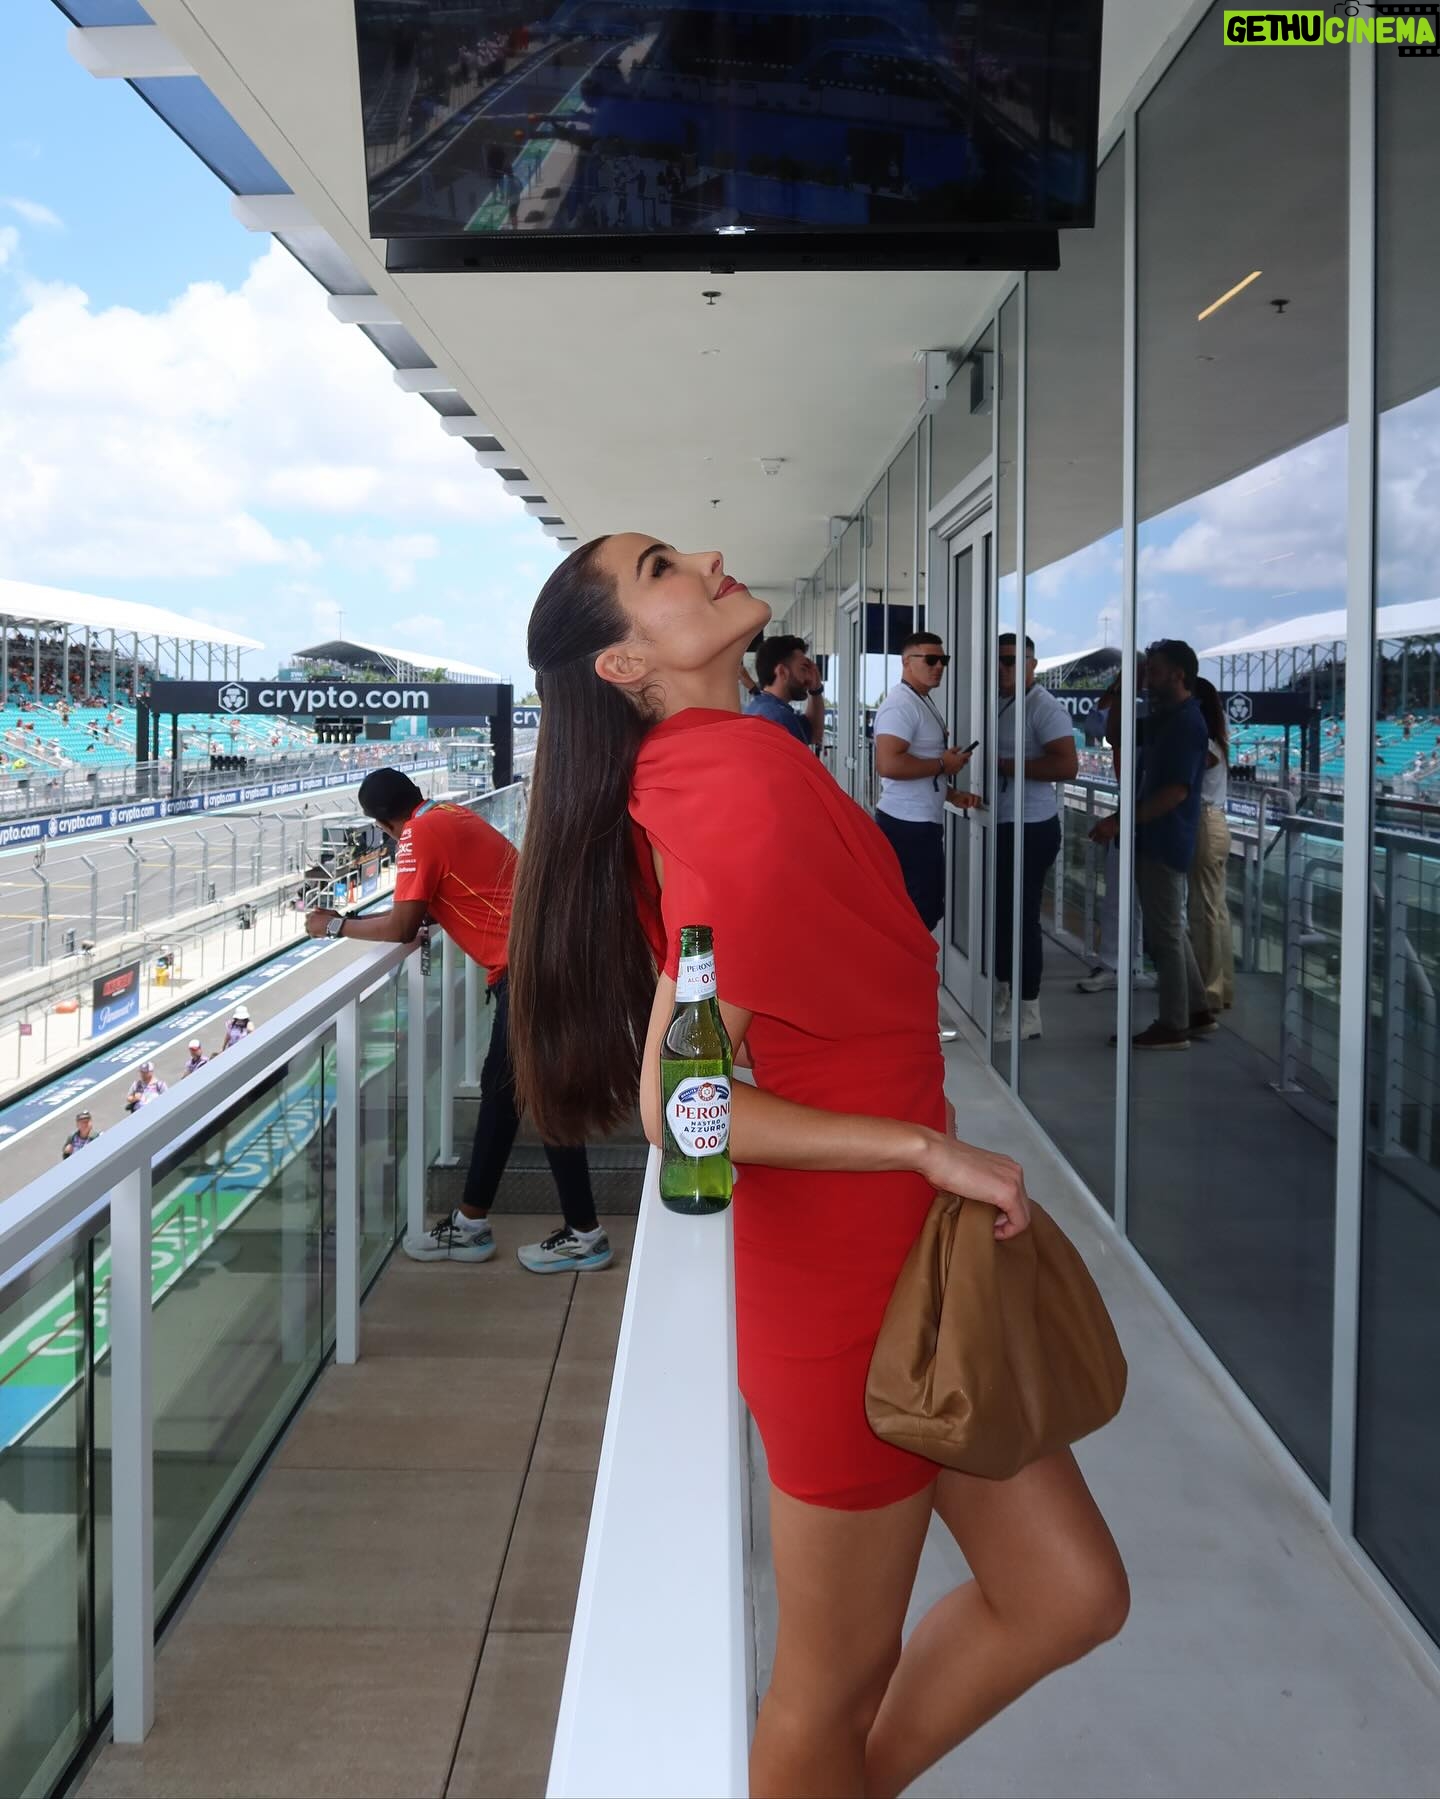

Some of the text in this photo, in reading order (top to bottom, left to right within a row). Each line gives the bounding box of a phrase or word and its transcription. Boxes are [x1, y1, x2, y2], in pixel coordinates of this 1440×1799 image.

[258, 686, 429, 712] crypto.com
[118, 805, 155, 823] crypto.com
[59, 814, 102, 833] crypto.com
[676, 1102, 730, 1120] PERONI
[684, 1123, 726, 1133] AZZURRO
[695, 1135, 718, 1150] 0.0
